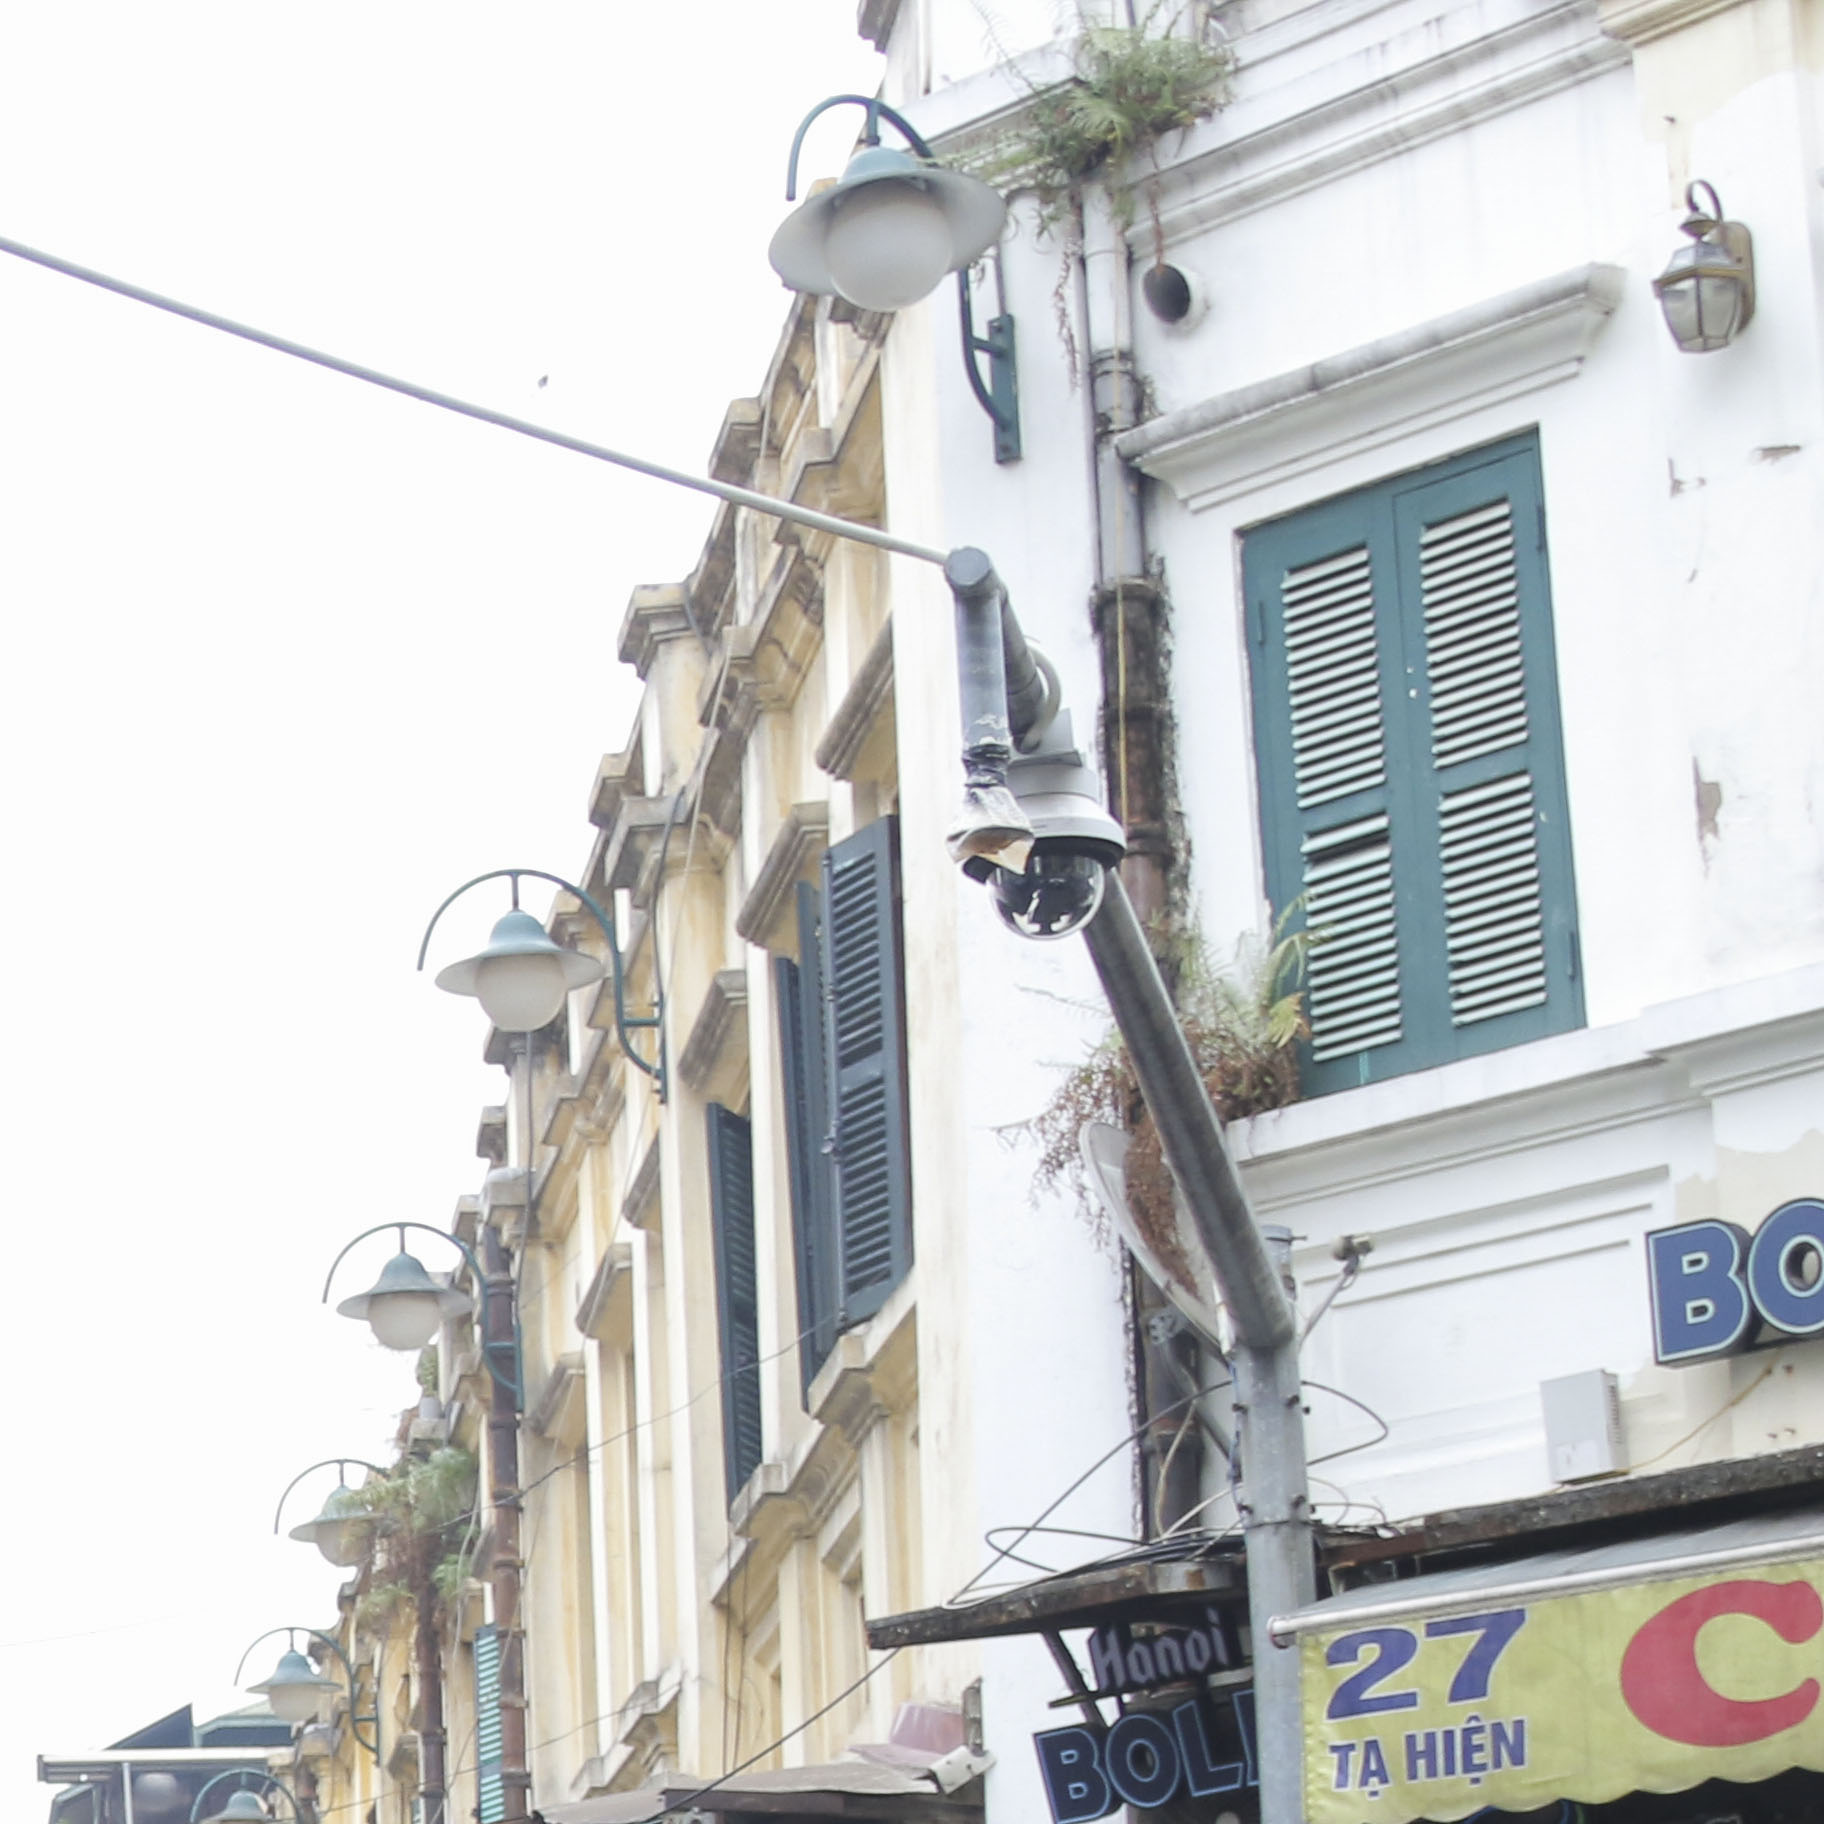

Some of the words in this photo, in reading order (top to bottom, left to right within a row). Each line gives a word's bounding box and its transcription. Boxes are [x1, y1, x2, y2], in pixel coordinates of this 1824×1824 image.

[1646, 1198, 1824, 1366] BO
[1088, 1607, 1230, 1693] Hanoi
[1326, 1607, 1527, 1721] 27
[1328, 1741, 1389, 1799] TẠ
[1405, 1715, 1528, 1786] HIỆN
